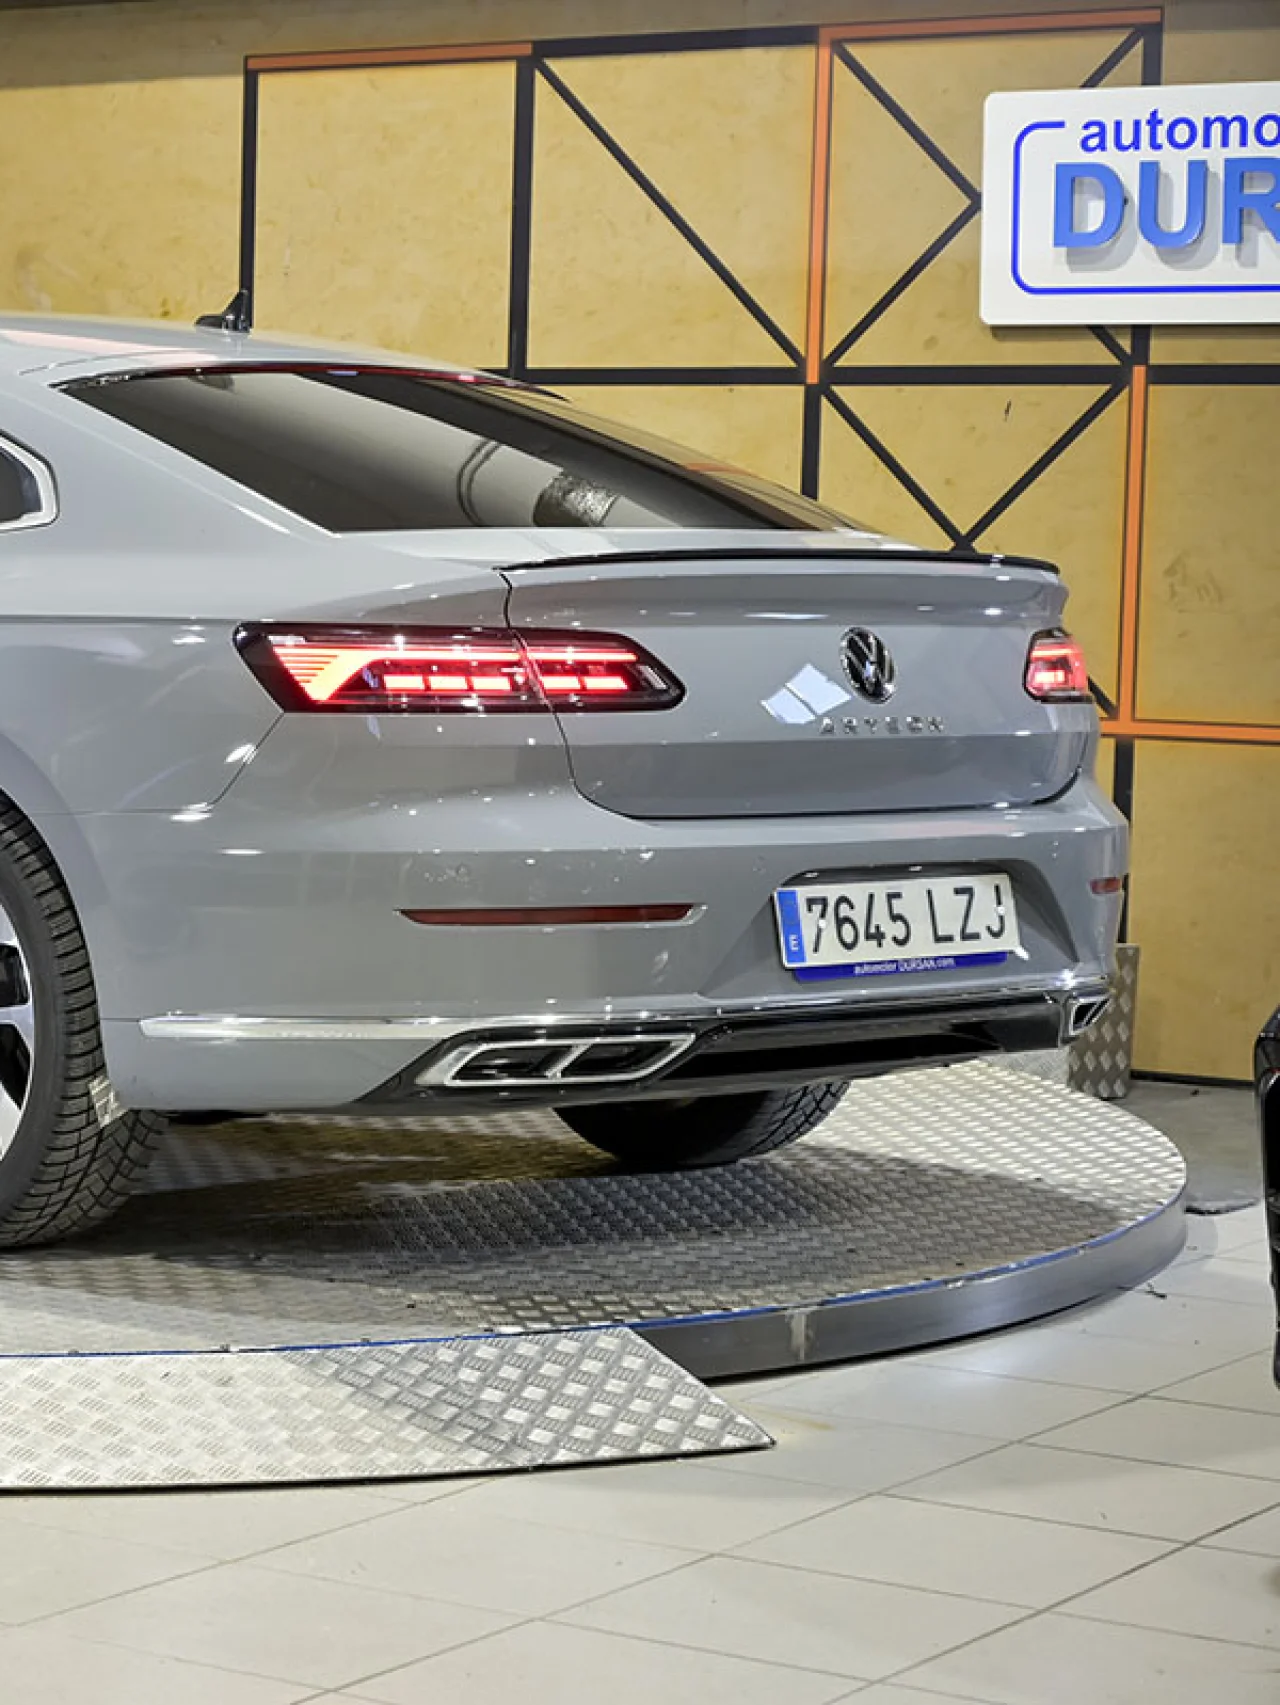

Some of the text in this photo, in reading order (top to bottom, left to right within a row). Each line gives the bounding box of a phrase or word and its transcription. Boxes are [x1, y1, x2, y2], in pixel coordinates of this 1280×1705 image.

[1080, 108, 1280, 152] automo
[1053, 157, 1280, 248] DUR
[790, 884, 1006, 953] E 7645 LZJ
